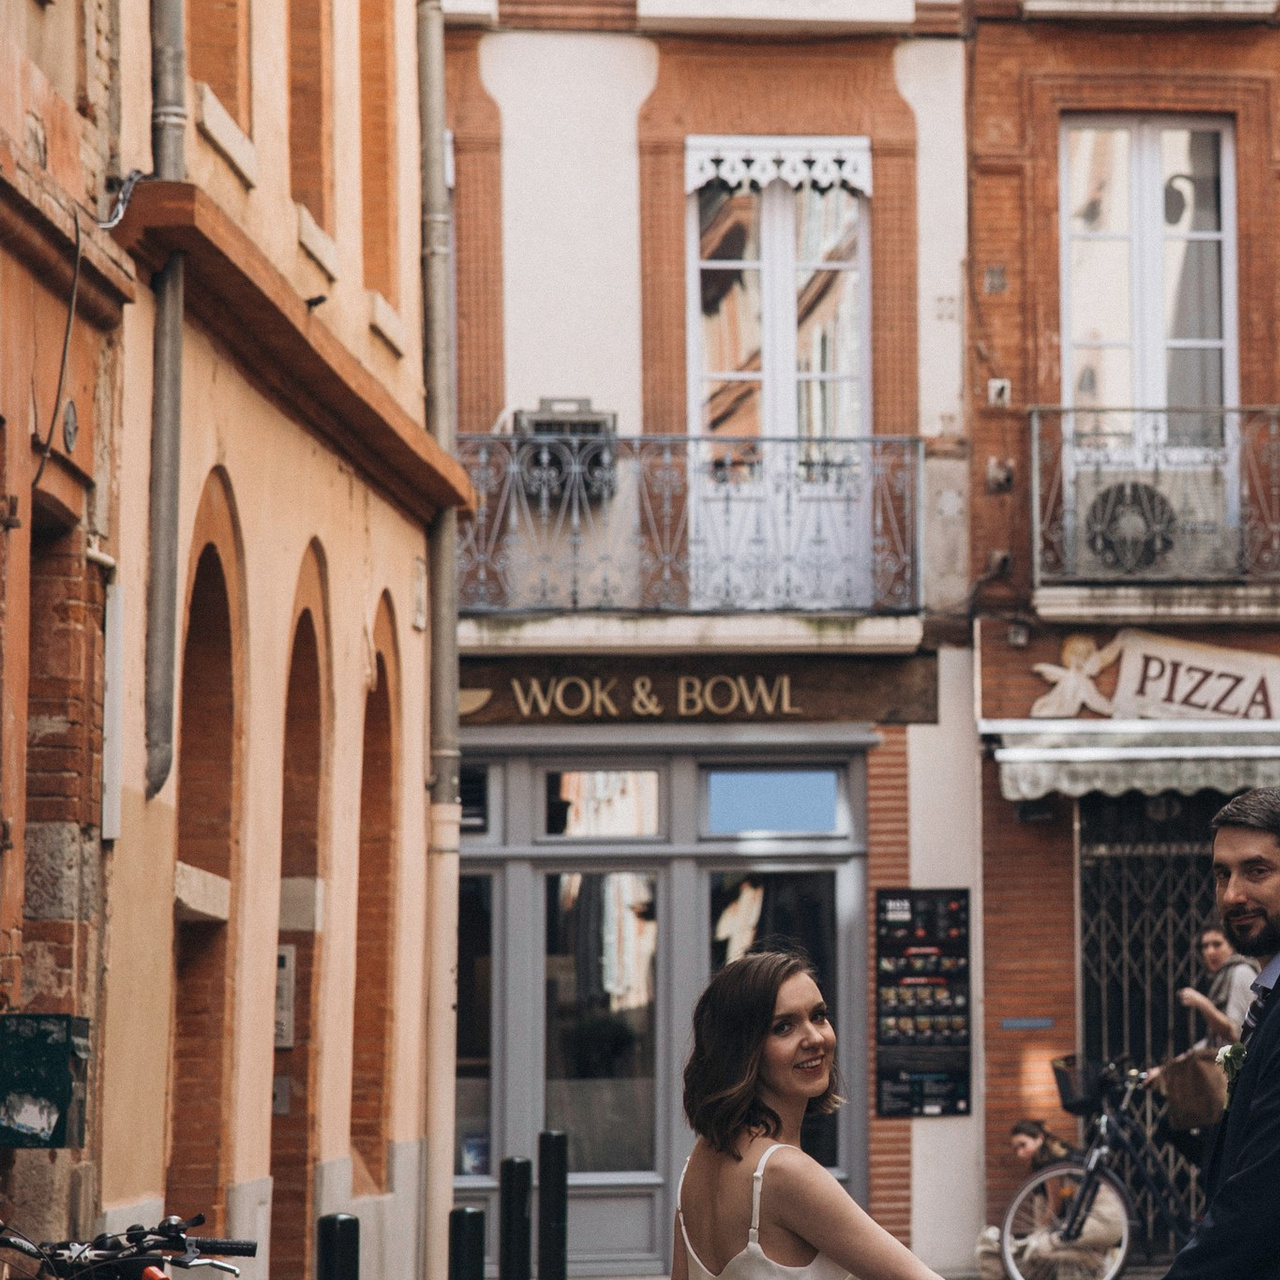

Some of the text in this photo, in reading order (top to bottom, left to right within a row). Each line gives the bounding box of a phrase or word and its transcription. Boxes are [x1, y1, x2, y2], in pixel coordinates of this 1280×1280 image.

[510, 674, 801, 716] WOK & BOWL
[1135, 653, 1274, 719] PIZZA
